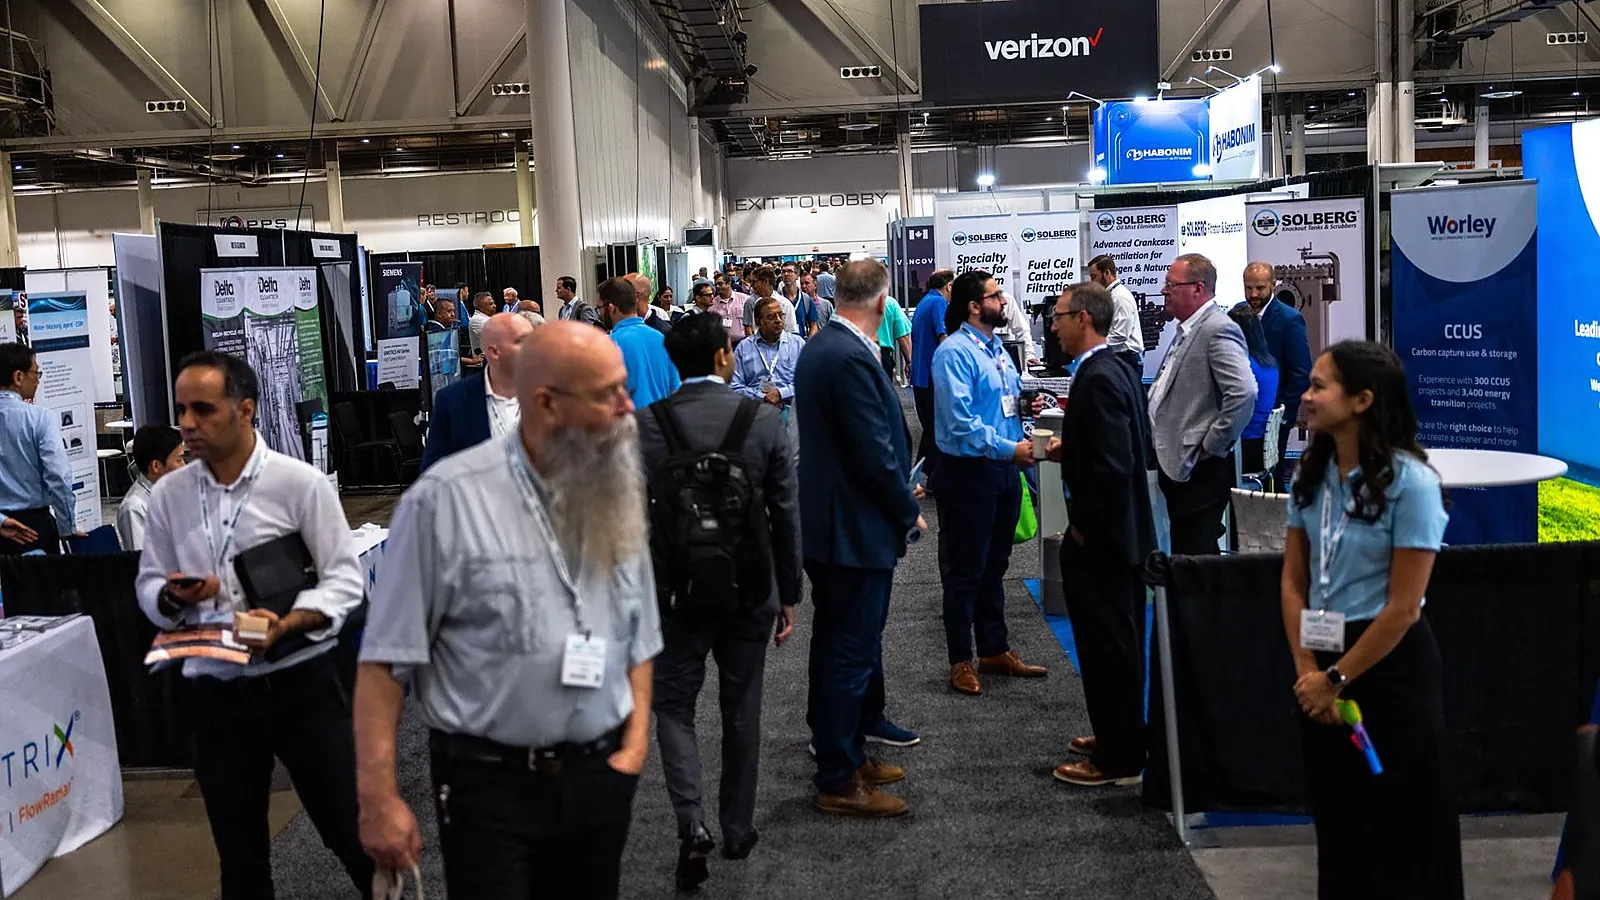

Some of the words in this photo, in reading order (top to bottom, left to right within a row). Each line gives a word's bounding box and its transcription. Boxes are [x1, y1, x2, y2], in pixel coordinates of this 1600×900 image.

[984, 33, 1090, 60] verizon
[1222, 123, 1255, 151] HABONIM
[1144, 148, 1192, 158] HABONIM
[735, 197, 779, 211] EXIT
[785, 196, 814, 209] TO
[818, 192, 889, 207] LOBBY
[417, 209, 522, 226] RESTROO
[1116, 214, 1166, 225] SOLBERG
[1281, 211, 1357, 227] SOLBERG
[1137, 223, 1166, 231] Eliminators
[1330, 223, 1357, 231] Scrubbers
[1427, 214, 1496, 239] Worley
[968, 232, 1008, 242] SOLBERG
[1037, 229, 1077, 239] SOLBERG
[1093, 239, 1132, 249] Advanced
[1134, 238, 1175, 248] Crankcase
[897, 258, 933, 266] VNCOV
[957, 252, 1007, 265] Specialty
[1150, 251, 1163, 261] for
[1028, 259, 1051, 270] Fuel
[1053, 257, 1074, 269] Cell
[1134, 264, 1142, 273] &
[382, 269, 403, 277] SIEMENS
[992, 264, 1008, 277] for
[1028, 270, 1074, 281] Cathode
[258, 276, 278, 293] Delta
[299, 277, 311, 291] Delta
[1127, 277, 1158, 287] Engines
[215, 280, 235, 297] Delta
[1444, 324, 1482, 339] CCUS
[1411, 348, 1437, 357] Carbon
[1437, 349, 1465, 359] capture
[1466, 350, 1480, 358] use
[1481, 349, 1488, 358] &
[1488, 350, 1517, 360] storage
[1419, 375, 1456, 385] Experience
[1456, 376, 1473, 385] with
[1474, 376, 1489, 385] 300
[1490, 377, 1510, 386] CCUS
[1418, 387, 1446, 397] projects
[1447, 388, 1460, 396] and
[1461, 388, 1483, 398] 3,400
[1484, 390, 1511, 400] energy
[1431, 399, 1465, 408] transition
[1467, 401, 1496, 410] projects
[1437, 421, 1449, 431] the
[1449, 423, 1467, 433] right
[1468, 424, 1492, 433] choice
[1493, 425, 1502, 434] to
[1503, 426, 1519, 436] help
[1427, 433, 1448, 441] create
[1456, 434, 1481, 444] cleaner
[1482, 436, 1496, 445] and
[1498, 438, 1517, 446] more
